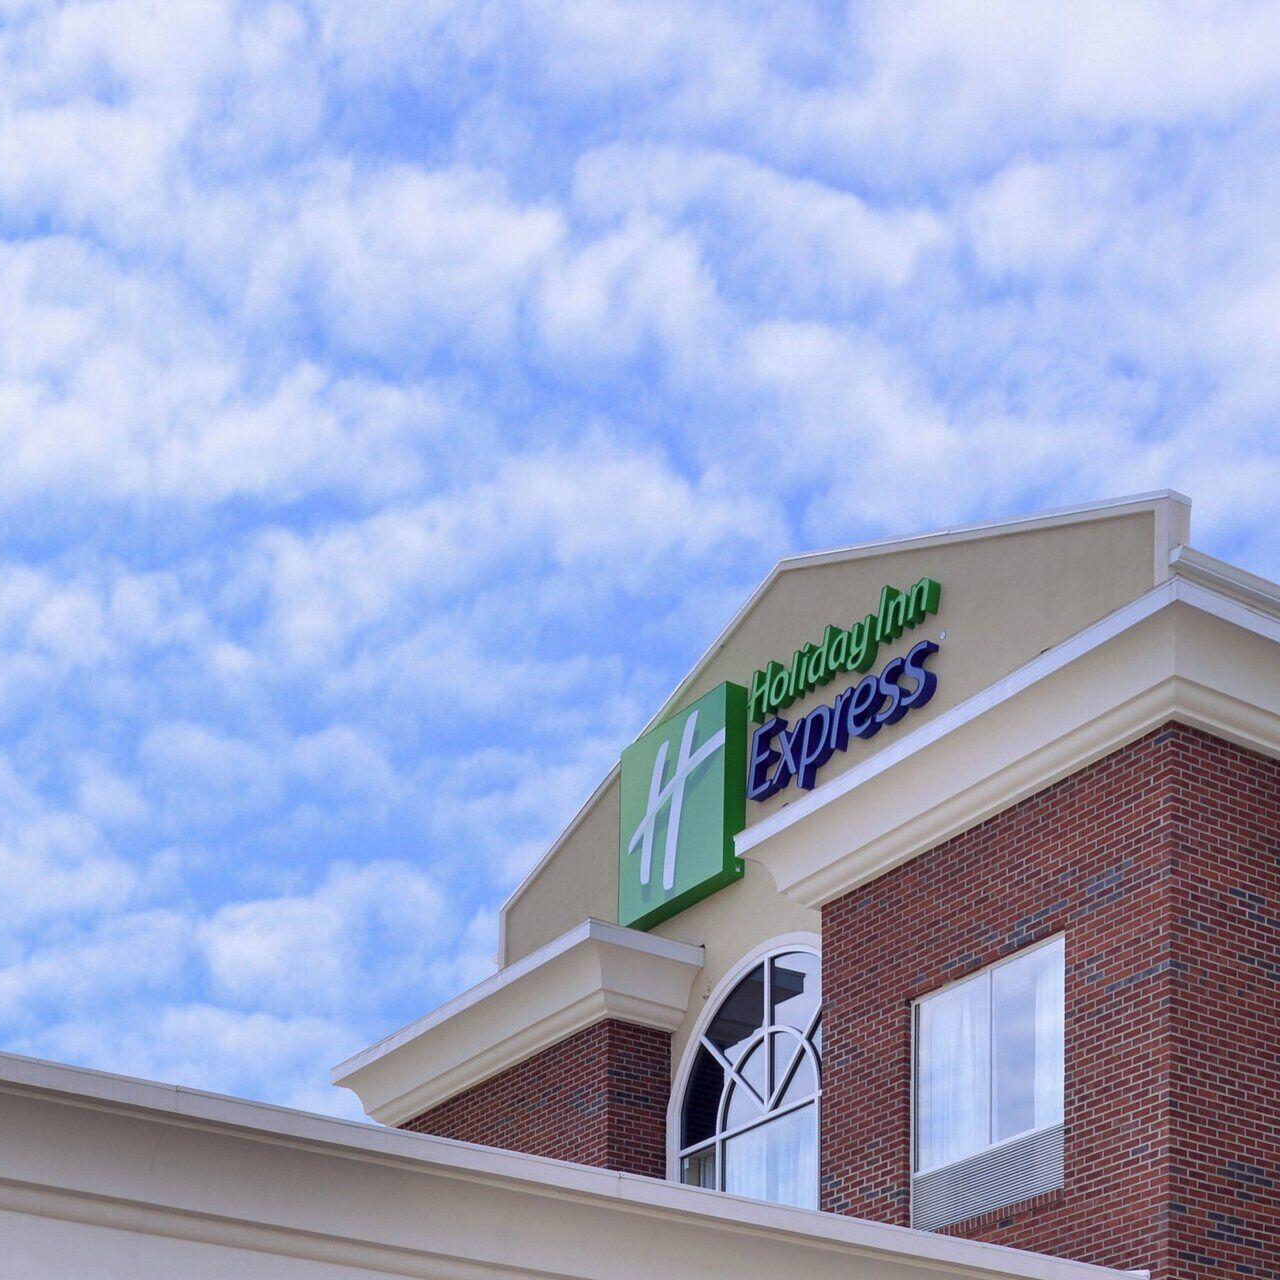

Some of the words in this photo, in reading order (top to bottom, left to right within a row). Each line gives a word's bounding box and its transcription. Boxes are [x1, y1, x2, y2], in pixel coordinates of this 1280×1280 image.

[748, 614, 878, 723] Holiday
[875, 577, 940, 643] Inn
[748, 640, 938, 801] Express
